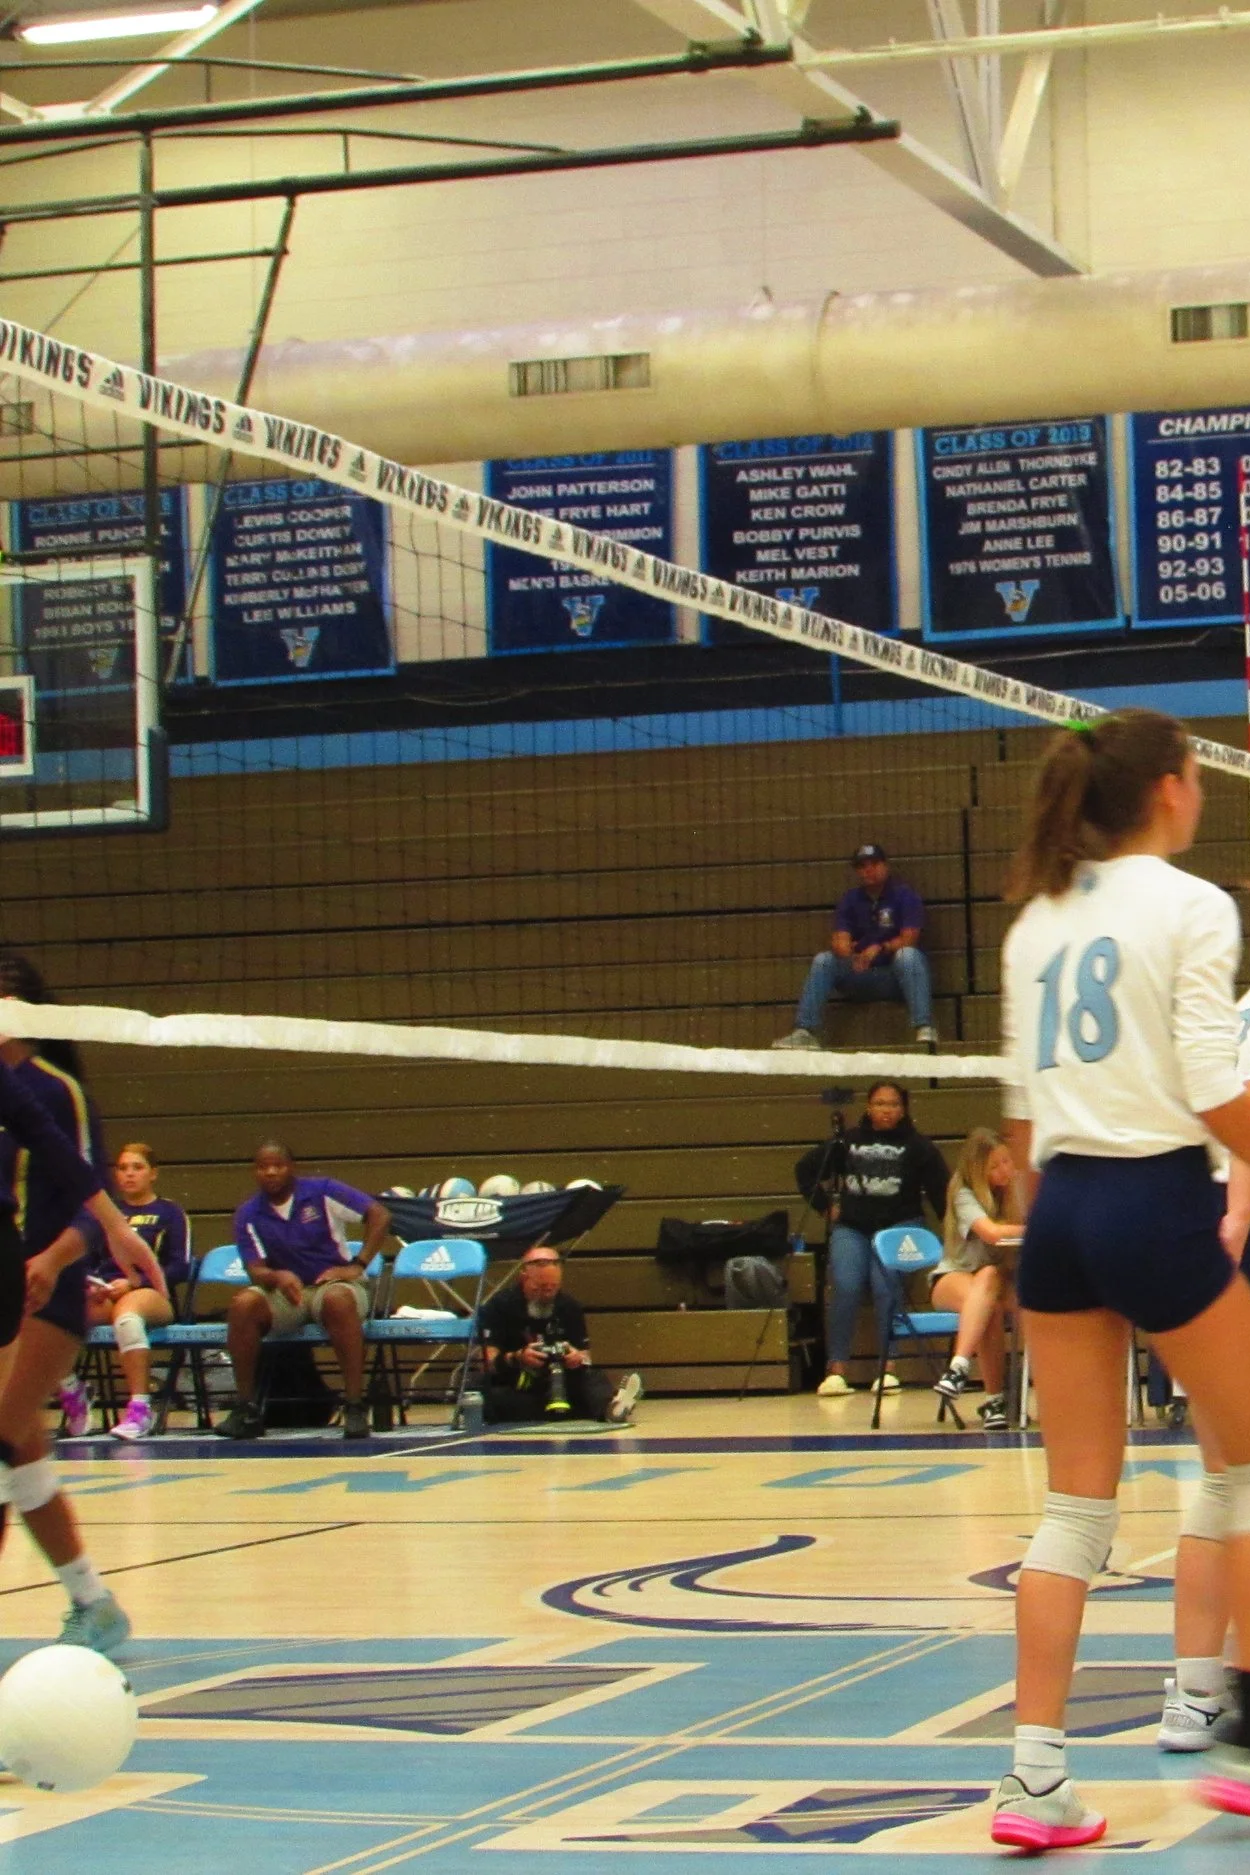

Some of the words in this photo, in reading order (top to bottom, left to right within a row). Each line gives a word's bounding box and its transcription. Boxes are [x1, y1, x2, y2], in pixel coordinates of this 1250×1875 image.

[138, 374, 226, 434] VIKINGS
[264, 416, 342, 469] VIKINGS
[935, 431, 1005, 454] CLASS
[1011, 428, 1041, 446] OF
[736, 467, 808, 483] ASHLEY
[809, 463, 857, 478] WAHL
[1155, 457, 1221, 479] 82-83
[508, 485, 553, 500] JOHN
[557, 479, 655, 496] PATTERSON
[749, 487, 791, 501] MIKE
[796, 483, 847, 499] GATTI
[945, 479, 1025, 498] NATHANIEL
[1029, 473, 1088, 490] CARTER
[1155, 481, 1222, 503] 84-85
[559, 504, 601, 519] FRYE
[606, 502, 652, 516] HART
[751, 506, 787, 521] KEN
[791, 503, 847, 518] CROW
[966, 500, 1028, 516] BRENDA
[1031, 493, 1068, 509] FRYE
[1156, 507, 1222, 529] 86-87
[732, 528, 794, 545] BOBBY
[798, 524, 862, 540] PURVIS
[983, 537, 1024, 552] ANNE
[1026, 534, 1055, 549] LEE
[1157, 531, 1222, 553] 90-91
[756, 549, 791, 562] MEL
[795, 545, 840, 559] VEST
[1045, 551, 1092, 567] TENNIS
[736, 568, 786, 583] KEITH
[791, 564, 860, 580] MARION
[1158, 556, 1225, 579] 92-93
[1159, 581, 1226, 604] 05-06
[242, 608, 273, 624] LEE
[277, 600, 357, 619] WILLIAMS
[1035, 936, 1120, 1072] 18
